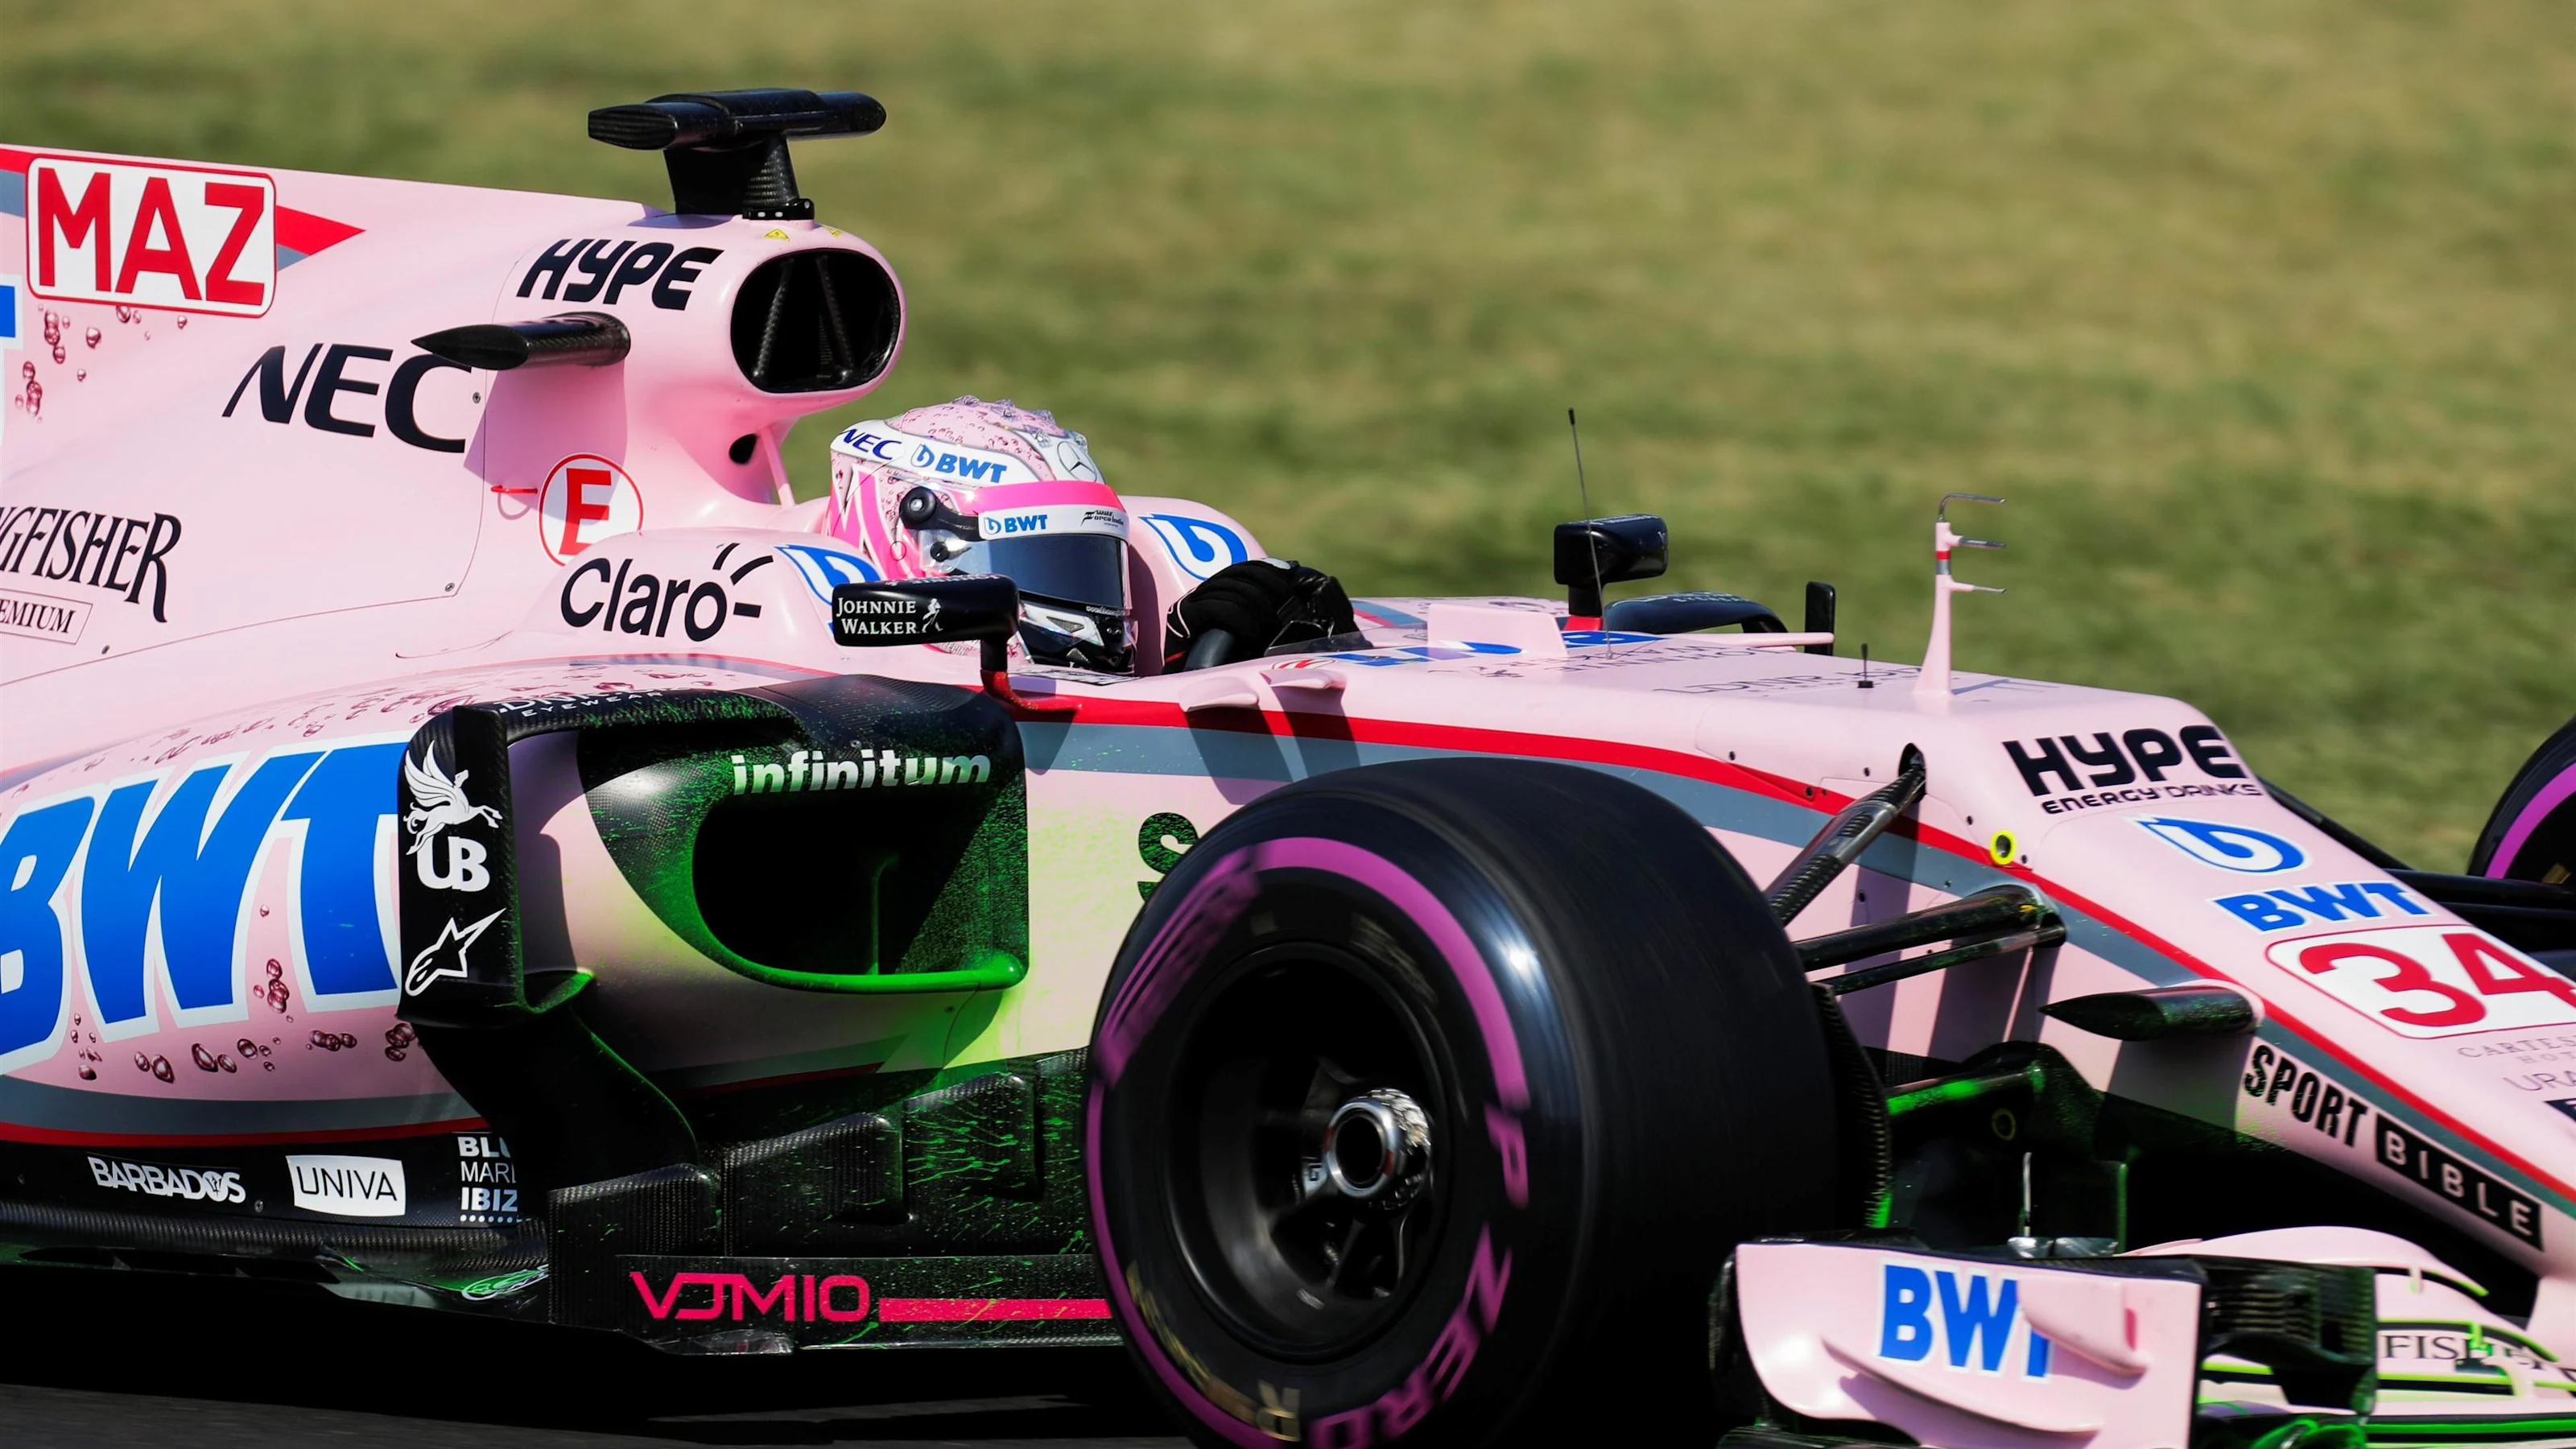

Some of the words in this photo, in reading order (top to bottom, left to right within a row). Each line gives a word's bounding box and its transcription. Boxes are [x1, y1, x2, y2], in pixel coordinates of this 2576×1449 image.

[38, 167, 265, 306] MAZ
[516, 238, 724, 311] HYPE
[221, 343, 473, 453] NEC
[840, 428, 902, 460] NEC
[935, 452, 1008, 483] BWT
[558, 468, 613, 555] E
[1005, 514, 1048, 533] BWT
[560, 558, 728, 642] Claro
[836, 597, 916, 617] JOHNNIE
[841, 618, 919, 634] WALKER
[522, 691, 663, 717] EYEWEAR
[731, 749, 990, 795] infinitum
[2001, 724, 2248, 797] HYPE
[2041, 787, 2161, 815] ENERGY
[2164, 783, 2264, 798] DRINKS
[416, 836, 490, 891] UB
[0, 741, 409, 1056] BWT
[2214, 882, 2432, 932] BWT
[2299, 933, 2576, 1027] 34
[2457, 1034, 2576, 1058] CARTES
[2244, 1045, 2368, 1147] SPORT
[2385, 1131, 2533, 1236] BIBLE
[87, 1156, 246, 1204] BARBADOS
[298, 1166, 397, 1201] UNIVA
